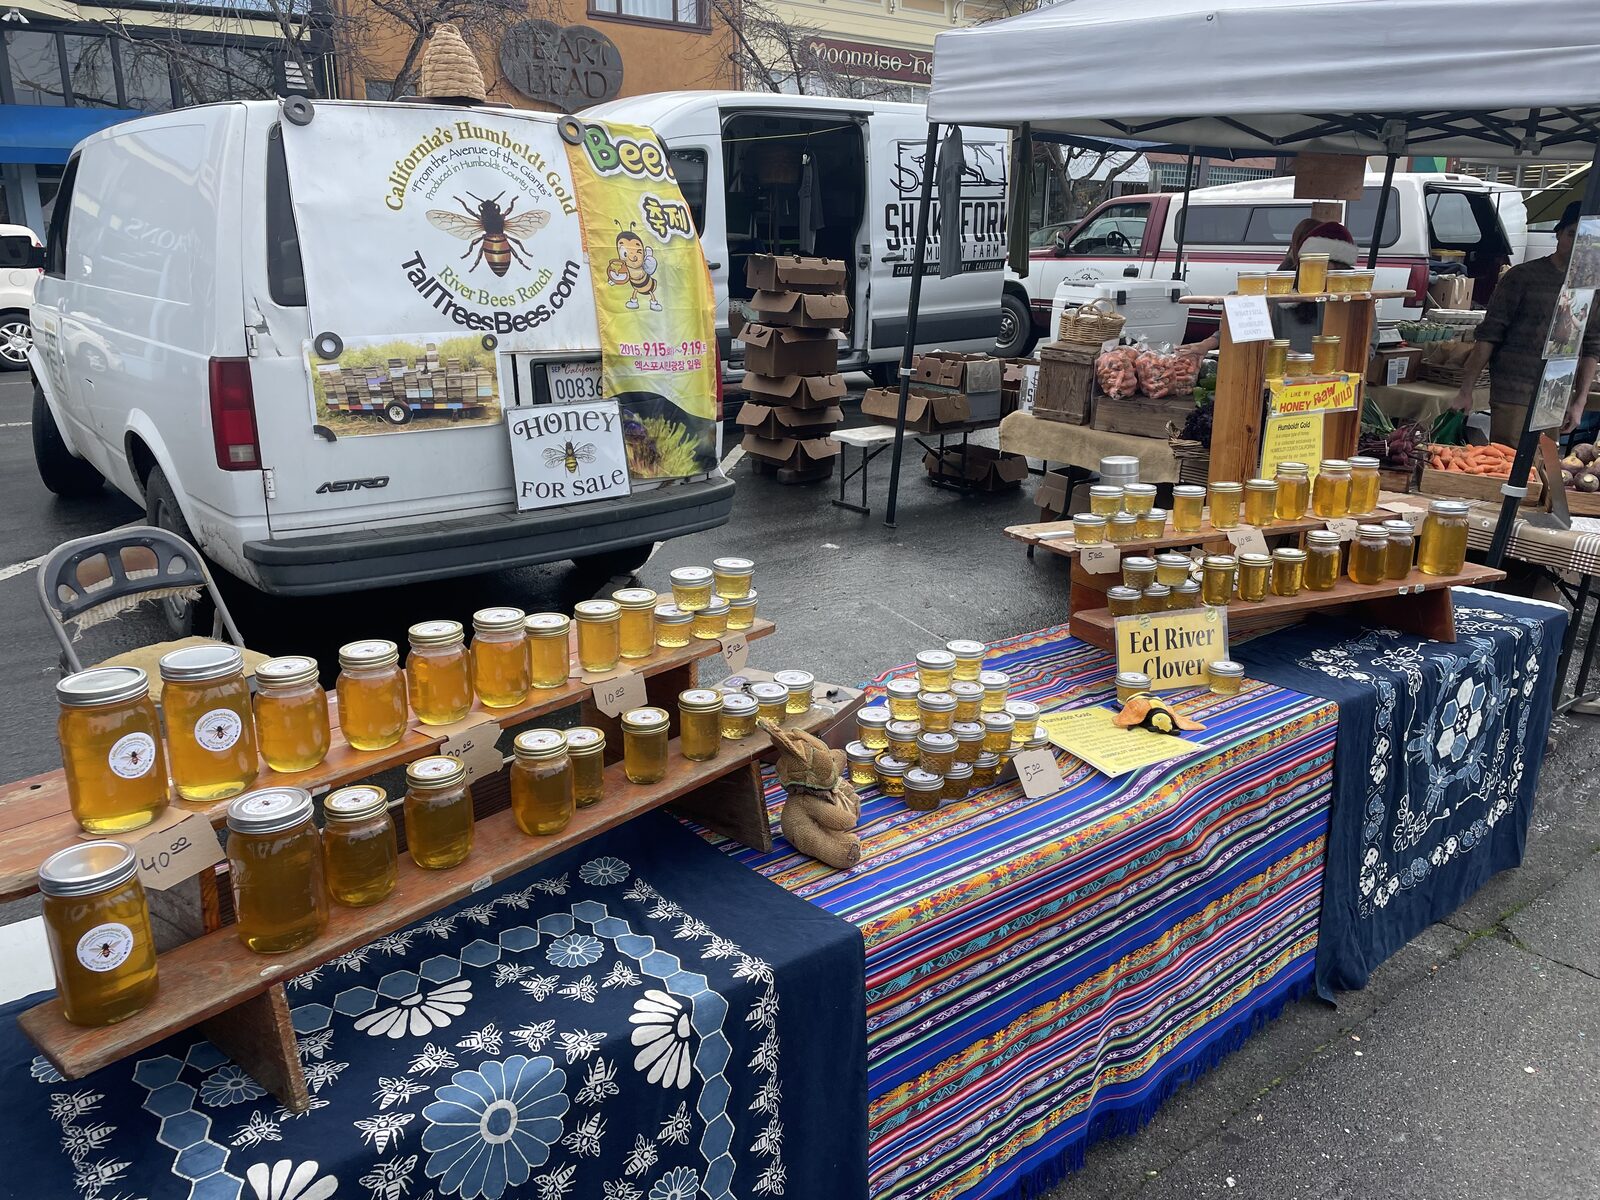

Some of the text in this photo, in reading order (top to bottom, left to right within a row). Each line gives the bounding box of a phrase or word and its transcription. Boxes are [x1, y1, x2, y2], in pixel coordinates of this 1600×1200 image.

[385, 121, 578, 217] California's Humboldt Gold
[432, 154, 449, 169] the
[449, 146, 489, 160] Avenue
[489, 147, 502, 158] of
[502, 152, 519, 169] the
[425, 165, 454, 201] Produced
[453, 161, 461, 173] in
[460, 156, 501, 171] Humboldt
[501, 166, 529, 192] County
[643, 196, 691, 239] 축제
[973, 244, 1000, 259] FARM
[401, 250, 581, 335] TallTreesBees.com
[437, 264, 553, 307] River Bees Ranch
[564, 363, 602, 376] Californ
[1280, 400, 1312, 413] HONEY
[1332, 384, 1353, 407] WILD
[315, 476, 390, 494] ASTRO
[520, 481, 567, 498] FOR
[1129, 622, 1216, 655] Eel River
[1142, 652, 1206, 682] Clover
